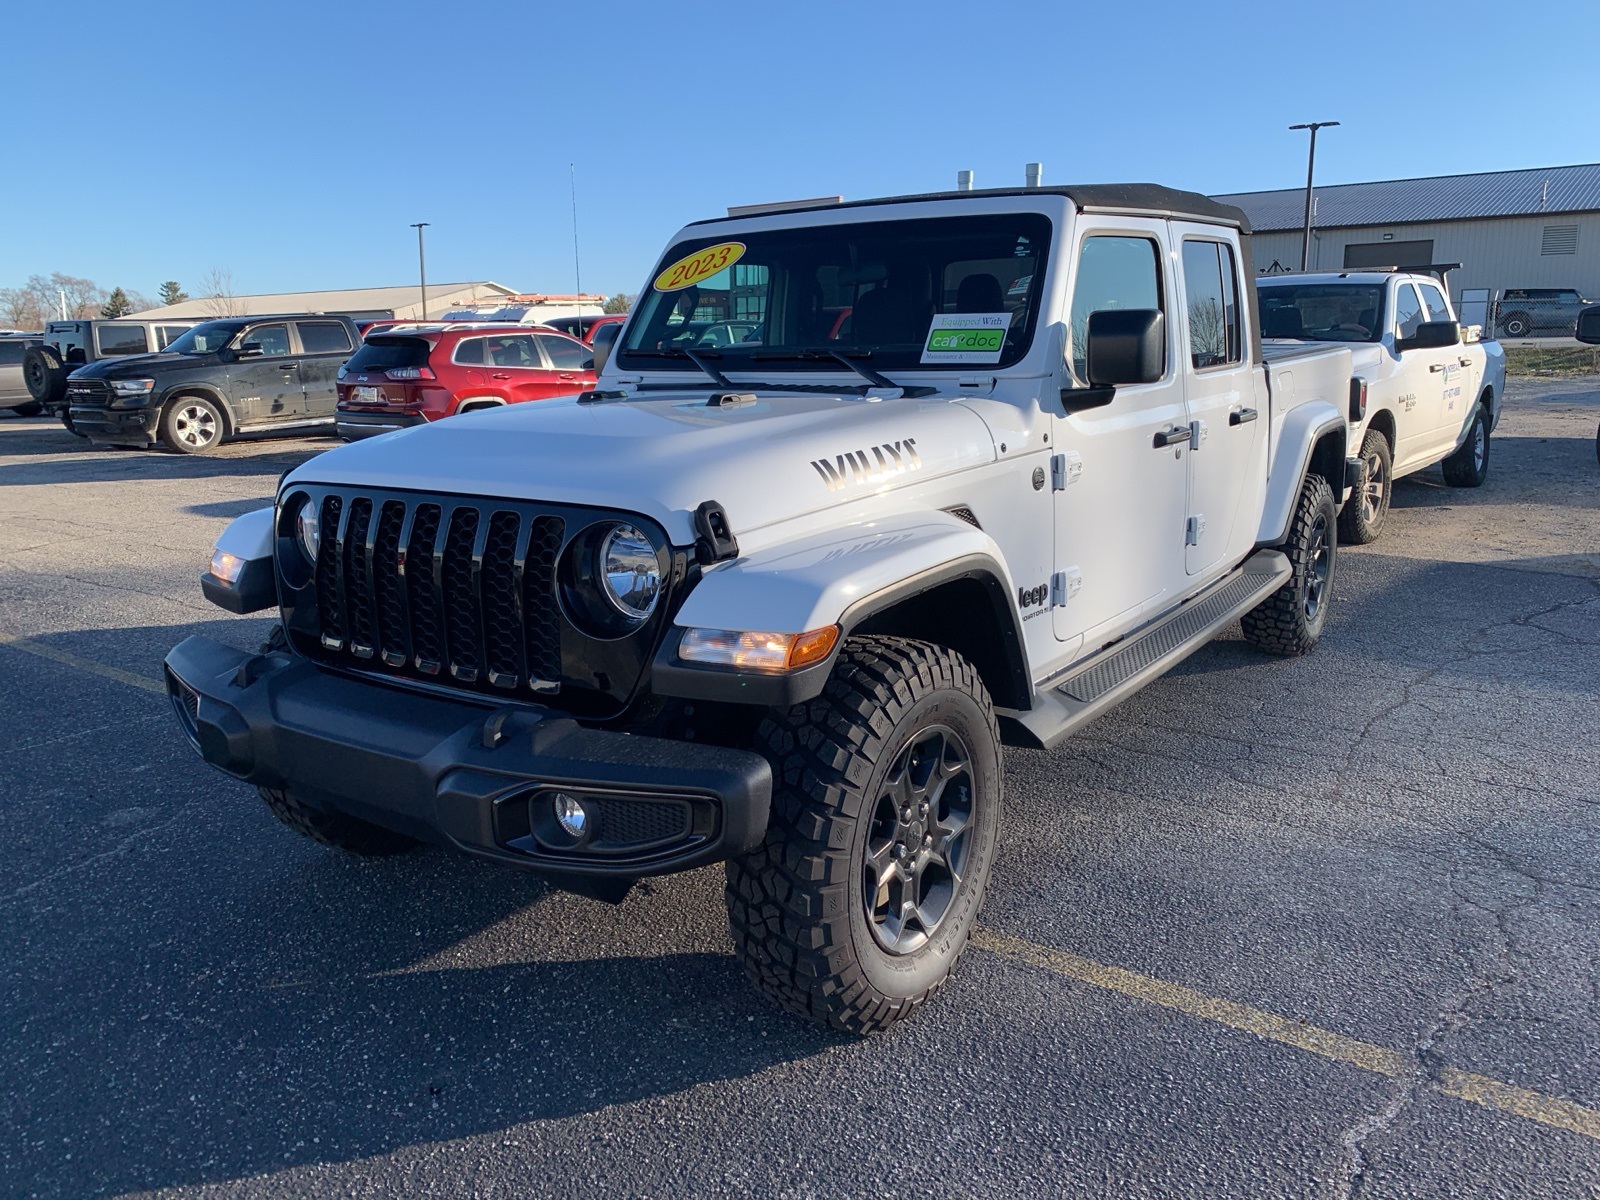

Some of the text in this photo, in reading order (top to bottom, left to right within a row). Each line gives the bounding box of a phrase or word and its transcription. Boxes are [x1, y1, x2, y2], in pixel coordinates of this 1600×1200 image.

[667, 246, 732, 288] 2023
[941, 317, 1002, 327] Equipped With
[809, 438, 923, 492] WILLYS
[1018, 583, 1048, 609] Jeep
